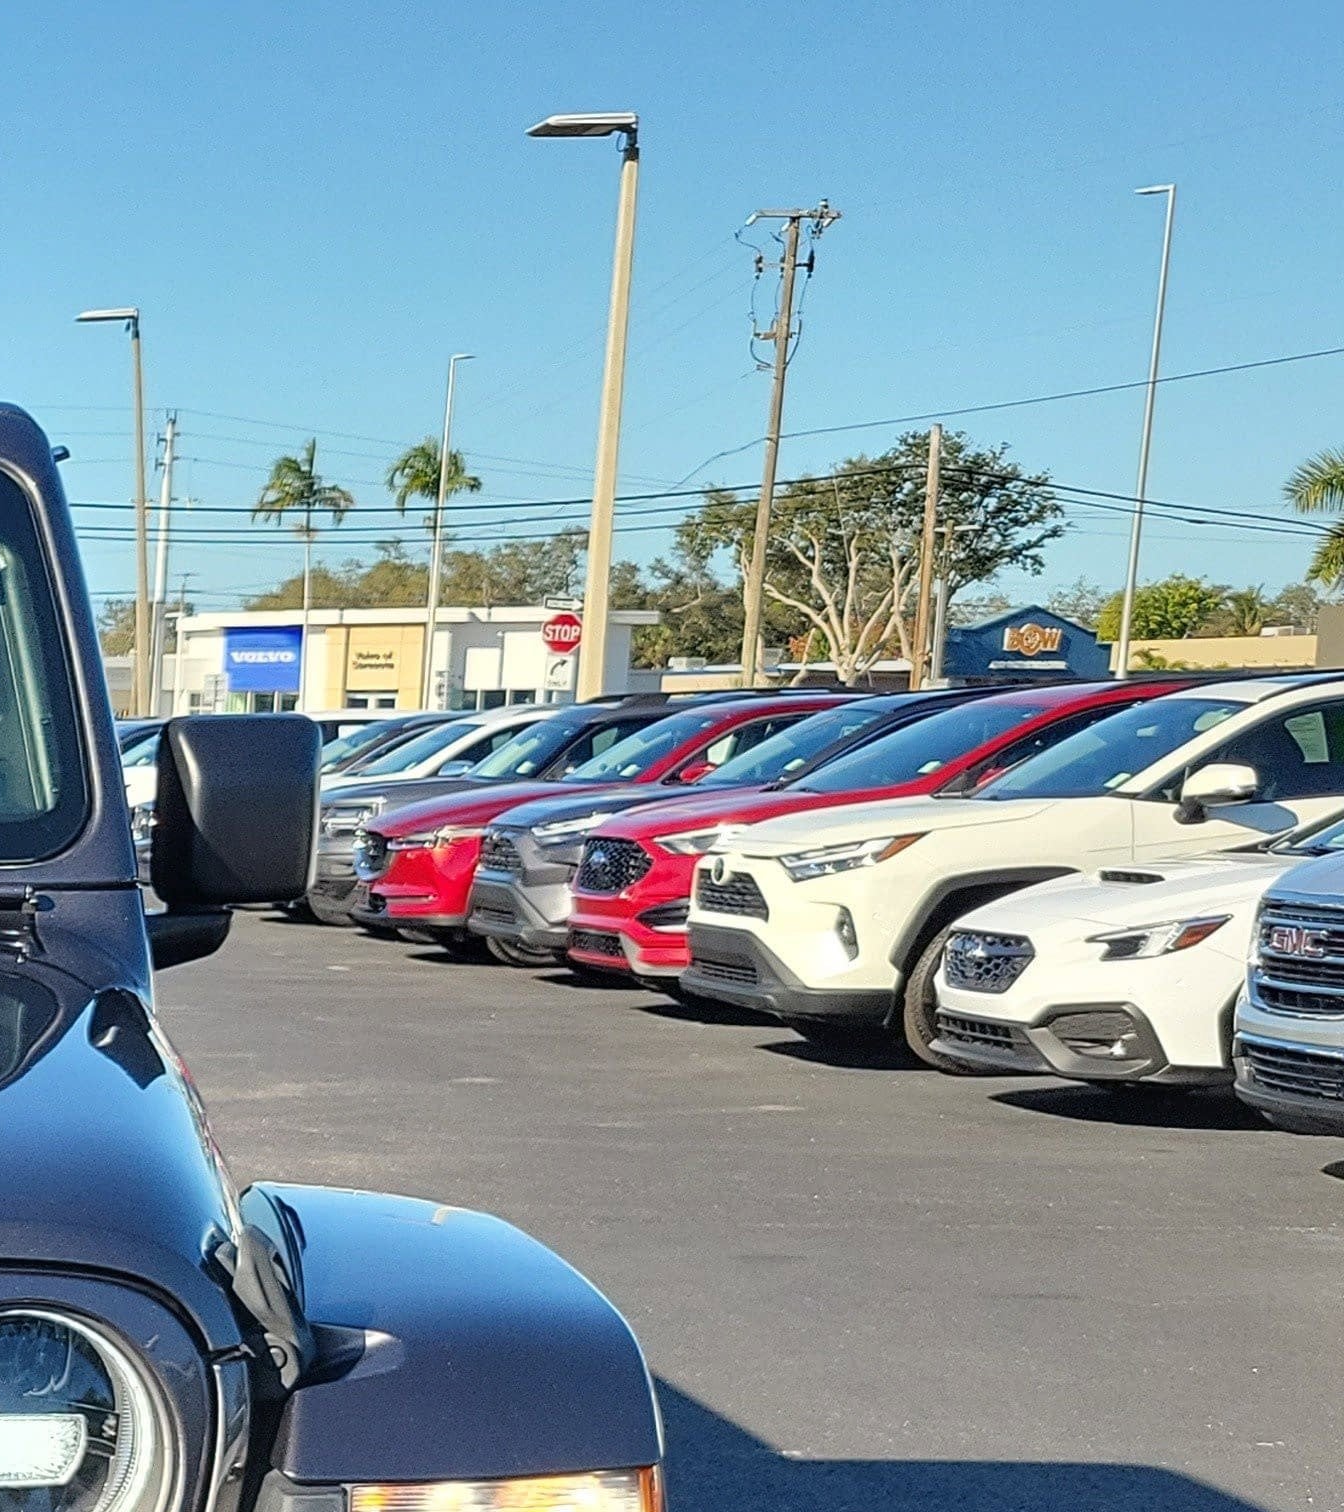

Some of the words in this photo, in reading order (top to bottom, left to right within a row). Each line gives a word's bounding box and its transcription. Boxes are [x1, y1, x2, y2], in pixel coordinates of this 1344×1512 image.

[544, 624, 580, 642] STOP
[230, 650, 297, 664] VOLVO
[1270, 926, 1329, 957] GMC
